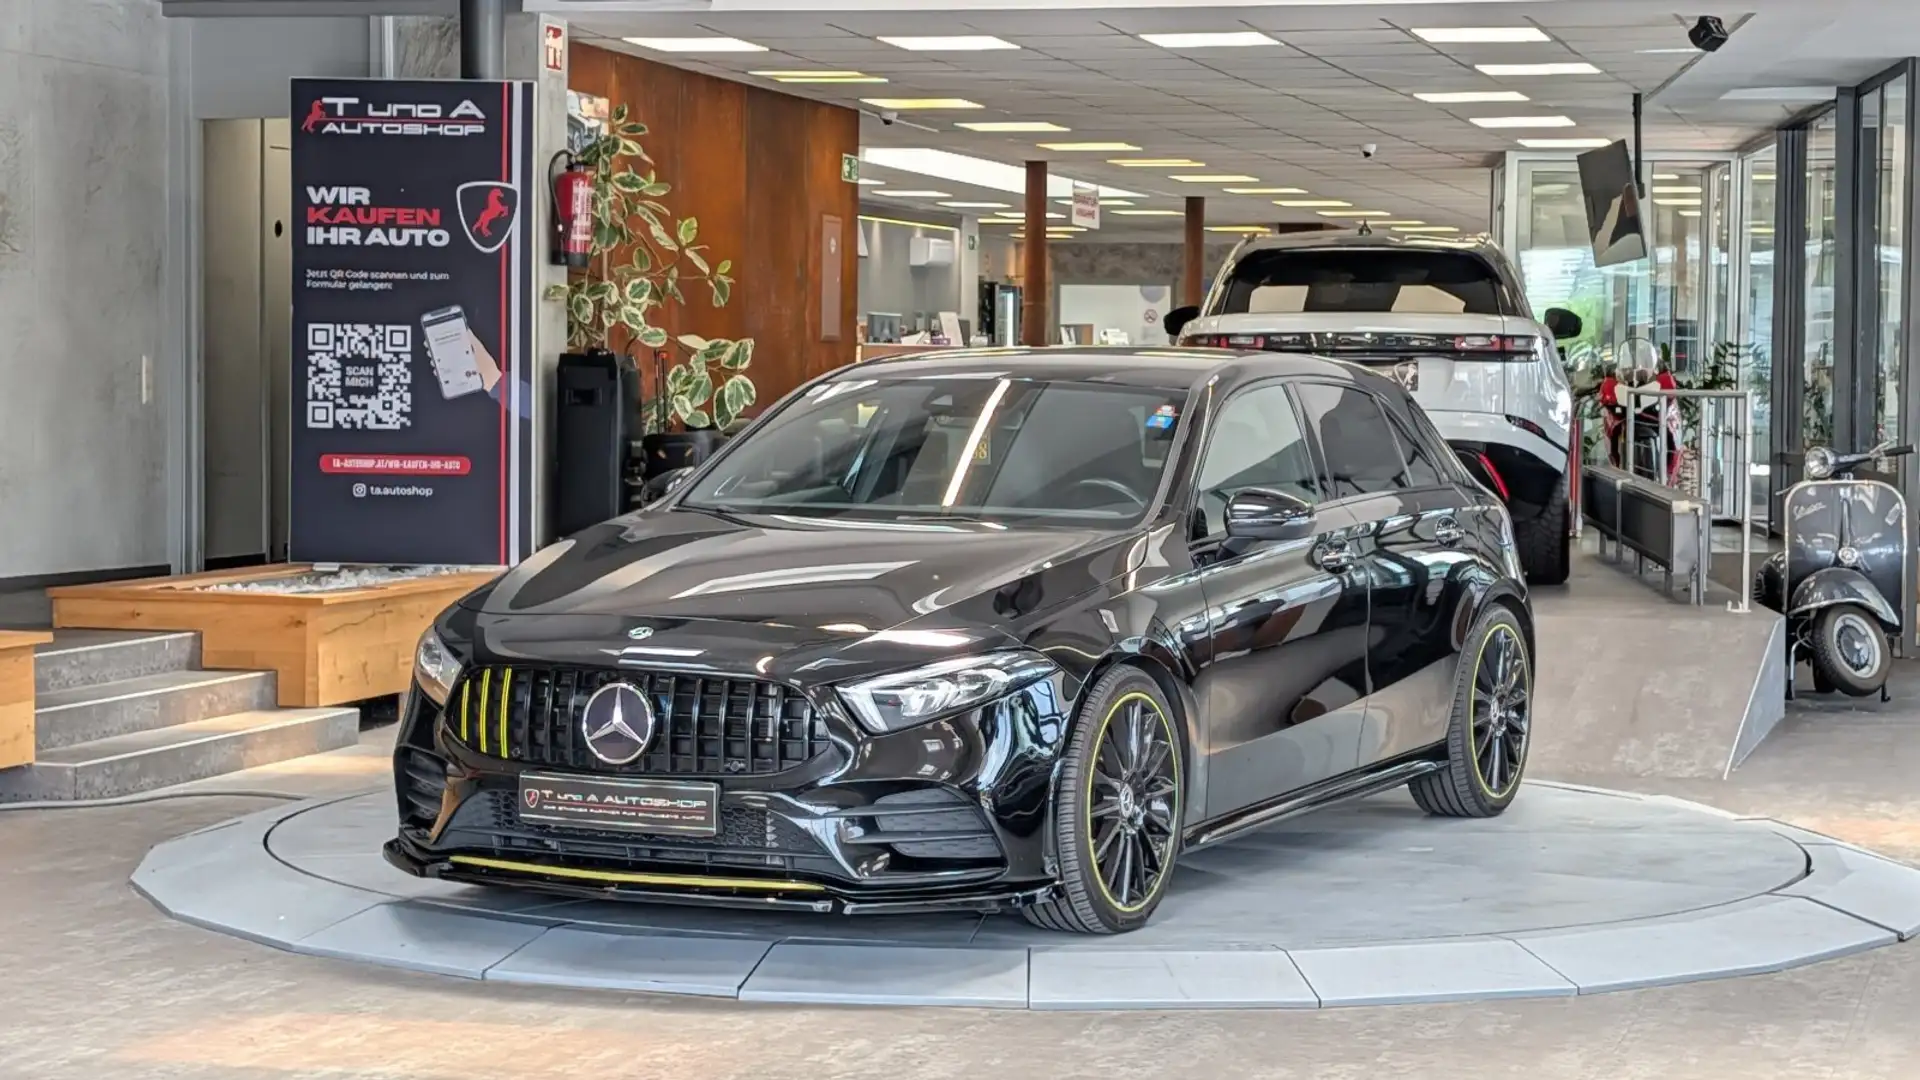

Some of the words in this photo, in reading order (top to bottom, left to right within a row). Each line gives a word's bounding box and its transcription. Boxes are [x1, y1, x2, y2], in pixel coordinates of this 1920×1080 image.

[322, 97, 359, 116] T
[449, 99, 486, 119] A
[322, 122, 485, 136] AUTOSHOP
[306, 186, 371, 205] WIR
[307, 207, 441, 226] KAUFEN
[306, 226, 361, 245] IHR
[364, 228, 450, 247] AUTO
[329, 270, 344, 279] QR
[345, 269, 369, 279] Code
[370, 271, 408, 279] scannen
[409, 271, 428, 280] und
[429, 272, 450, 280] zum
[306, 279, 347, 289] Formular
[345, 366, 374, 376] SCAN
[345, 376, 374, 387] MICH
[369, 485, 434, 498] ta.autoshop
[540, 789, 554, 799] T
[586, 793, 599, 803] A
[603, 795, 707, 809] AUTOSHOP
